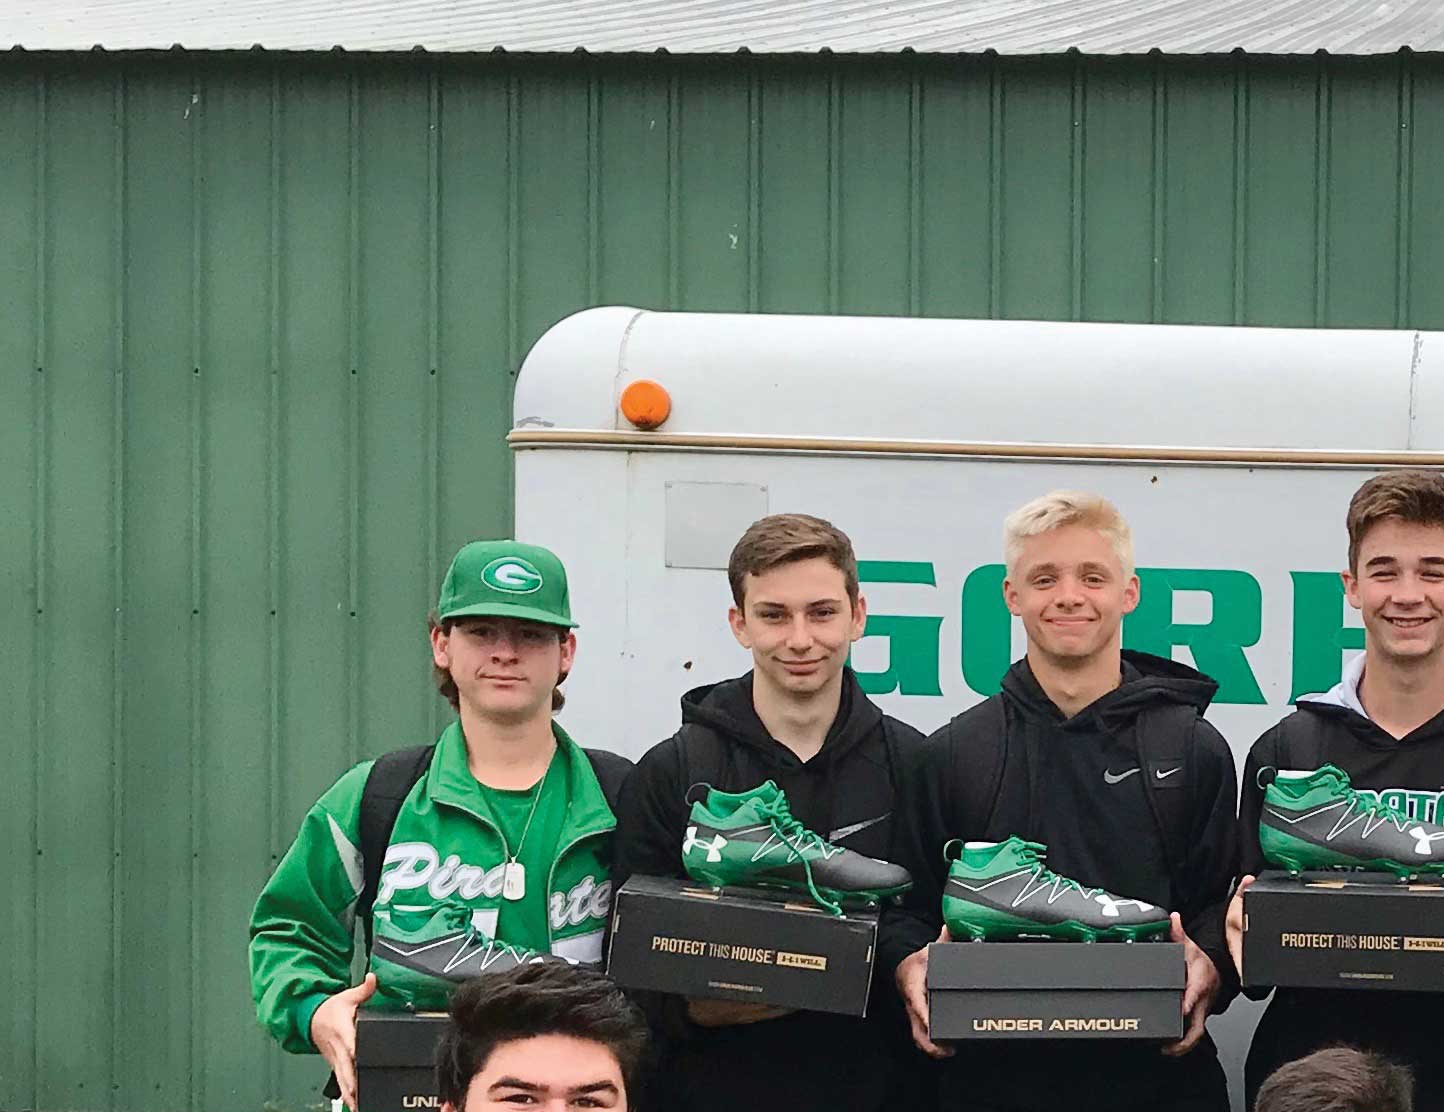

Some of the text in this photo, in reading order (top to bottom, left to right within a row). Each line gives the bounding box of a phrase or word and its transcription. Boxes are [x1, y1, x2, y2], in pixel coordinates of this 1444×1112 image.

[651, 936, 707, 956] PROTECT
[708, 942, 731, 959] THIS
[1281, 933, 1334, 948] PROTECT
[1336, 934, 1357, 949] THIS
[973, 1018, 1139, 1031] UNDER ARMOUR
